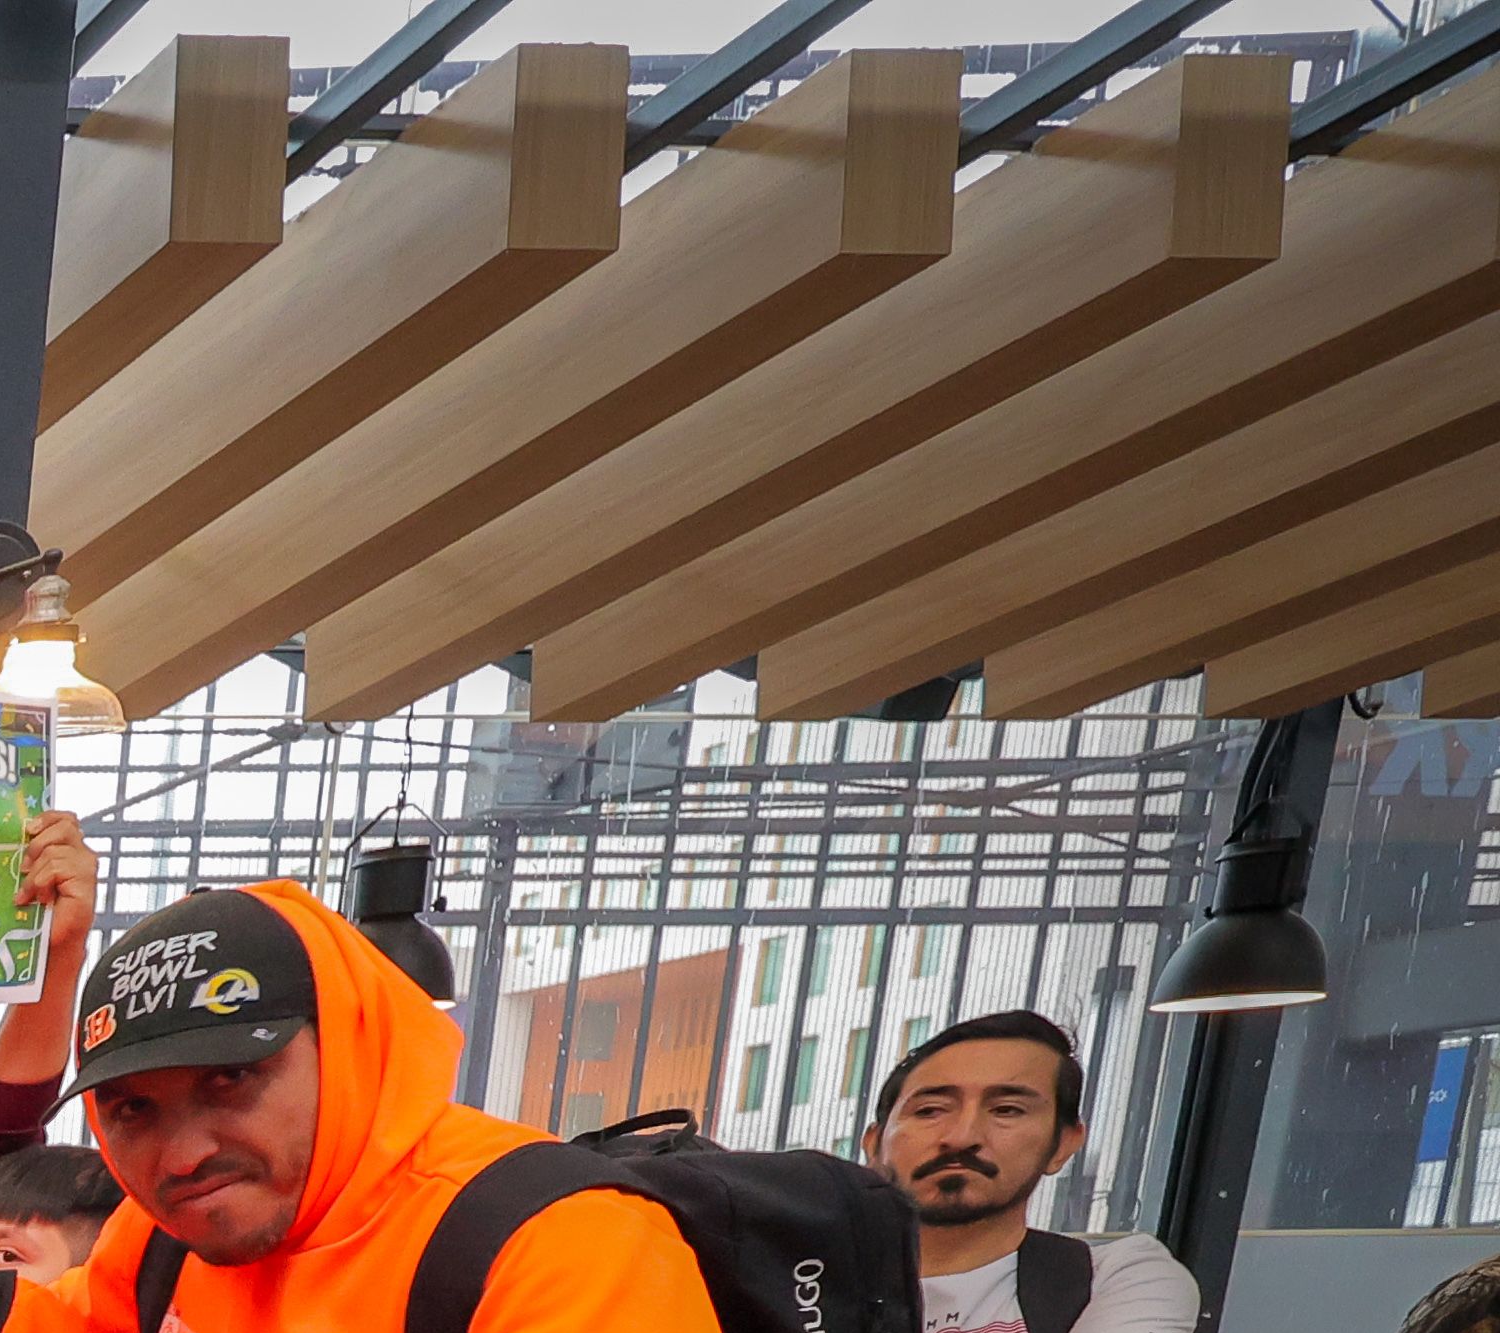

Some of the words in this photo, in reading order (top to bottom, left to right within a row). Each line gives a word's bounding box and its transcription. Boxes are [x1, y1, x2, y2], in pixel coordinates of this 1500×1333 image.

[107, 930, 219, 979] SUPER
[111, 954, 208, 1002] BOWL
[126, 983, 179, 1020] LVI
